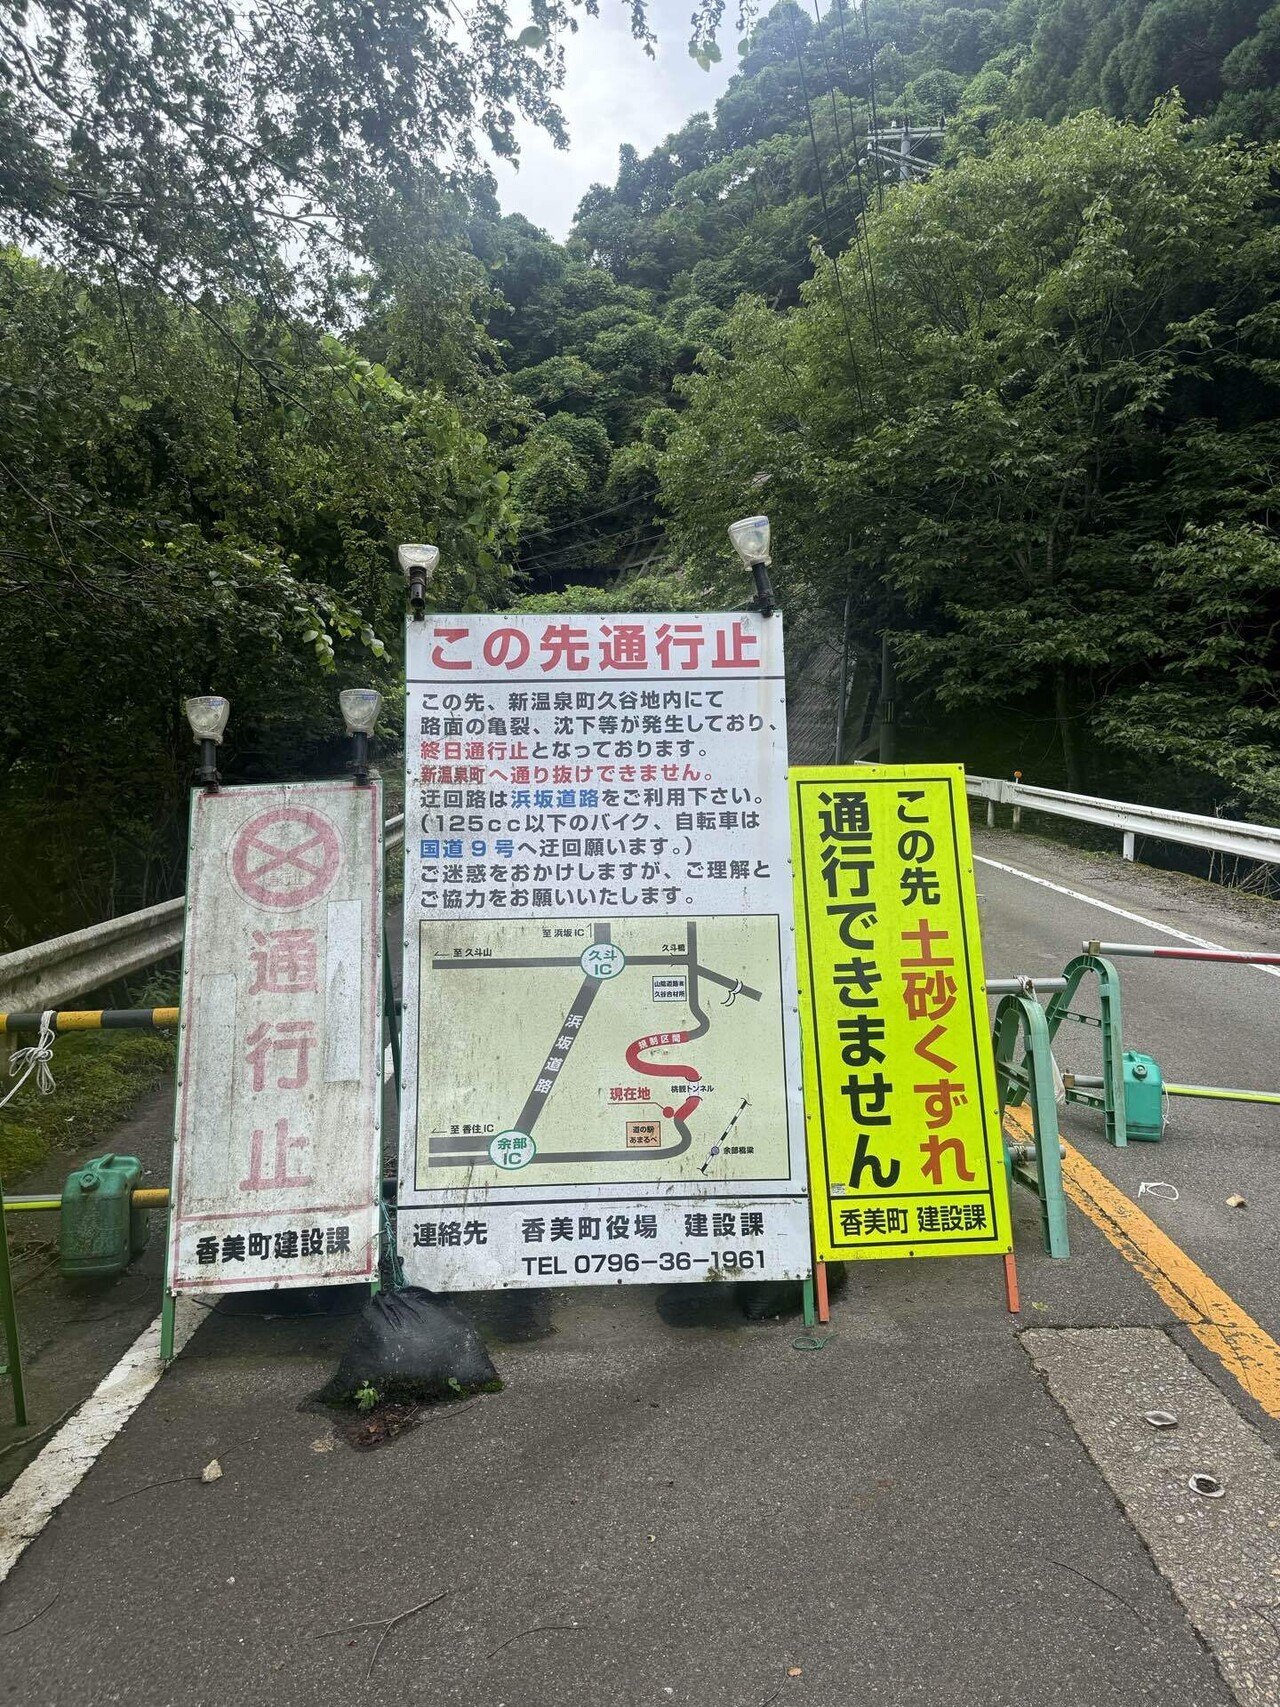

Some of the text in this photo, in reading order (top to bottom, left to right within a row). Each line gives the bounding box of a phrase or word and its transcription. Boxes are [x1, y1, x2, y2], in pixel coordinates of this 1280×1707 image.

[432, 622, 762, 672] この先通行止
[421, 690, 726, 712] この先、新温泉町久谷地内にて
[420, 716, 776, 737] 路面の亀裂、沈下等が発生しており、
[420, 741, 707, 761] 終日通行止となっております。
[420, 764, 713, 785] 新温泉町へ通り抜けできません。
[420, 788, 762, 809] 迂回路は浜坂道路をご利用下さい。
[420, 861, 771, 884] ご迷惑をおかけしますが、ご理解と
[420, 886, 694, 909] ご協力をお願いいたします。
[542, 928, 585, 938] 至 浜坂 IC
[453, 948, 492, 957] 至 久斗山
[588, 951, 618, 962] 久斗
[594, 964, 612, 975] IC
[817, 790, 901, 1190] 通行できません
[896, 790, 975, 1185] この先 土砂くずれ
[238, 928, 319, 1191] 通行止
[534, 1014, 584, 1094] 浜坂道路
[610, 1087, 651, 1101] 現在地
[450, 1124, 494, 1134] 至 香住 IC
[497, 1137, 528, 1150] 余部
[503, 1153, 522, 1165] IC
[521, 1212, 765, 1241] 香美町役場 建設課
[840, 1203, 988, 1236] 香美町 建設課
[196, 1225, 351, 1265] 香美町建設課
[413, 1220, 488, 1248] 連絡先
[521, 1249, 766, 1276] TEL 0796-36-1961
